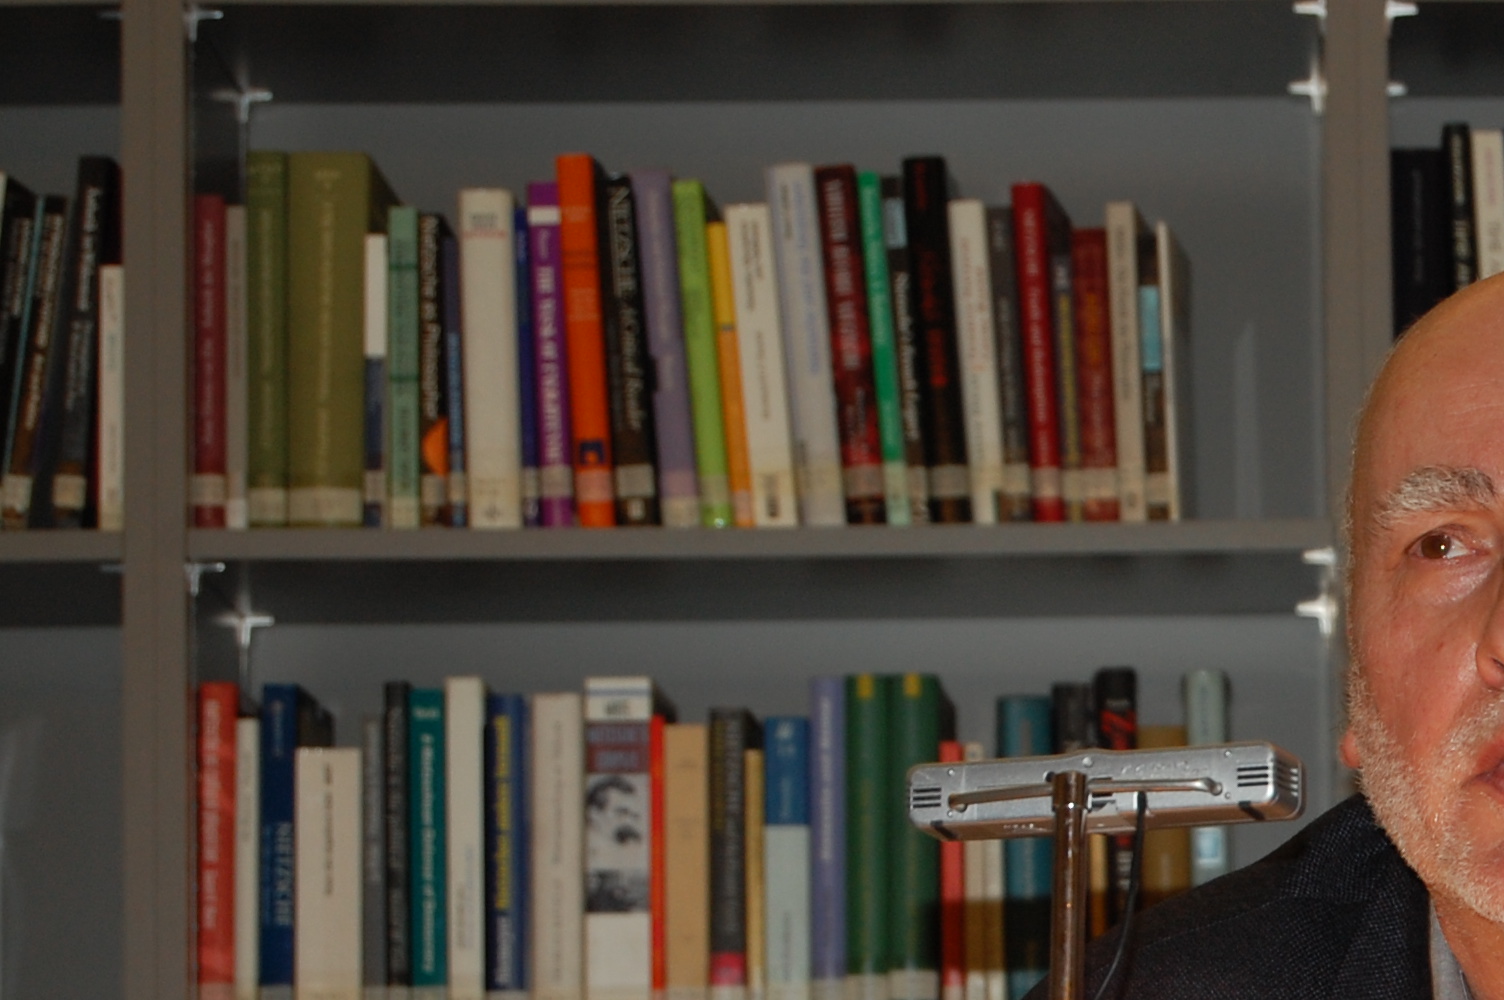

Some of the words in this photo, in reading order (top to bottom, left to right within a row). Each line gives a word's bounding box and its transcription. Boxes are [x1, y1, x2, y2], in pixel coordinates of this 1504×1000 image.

[422, 217, 438, 297] Nietzsche
[608, 187, 636, 297] NIETZSCHE
[422, 325, 440, 418] Philosopher
[275, 820, 292, 925] NIETZSCHE
[419, 901, 437, 973] Democracy
